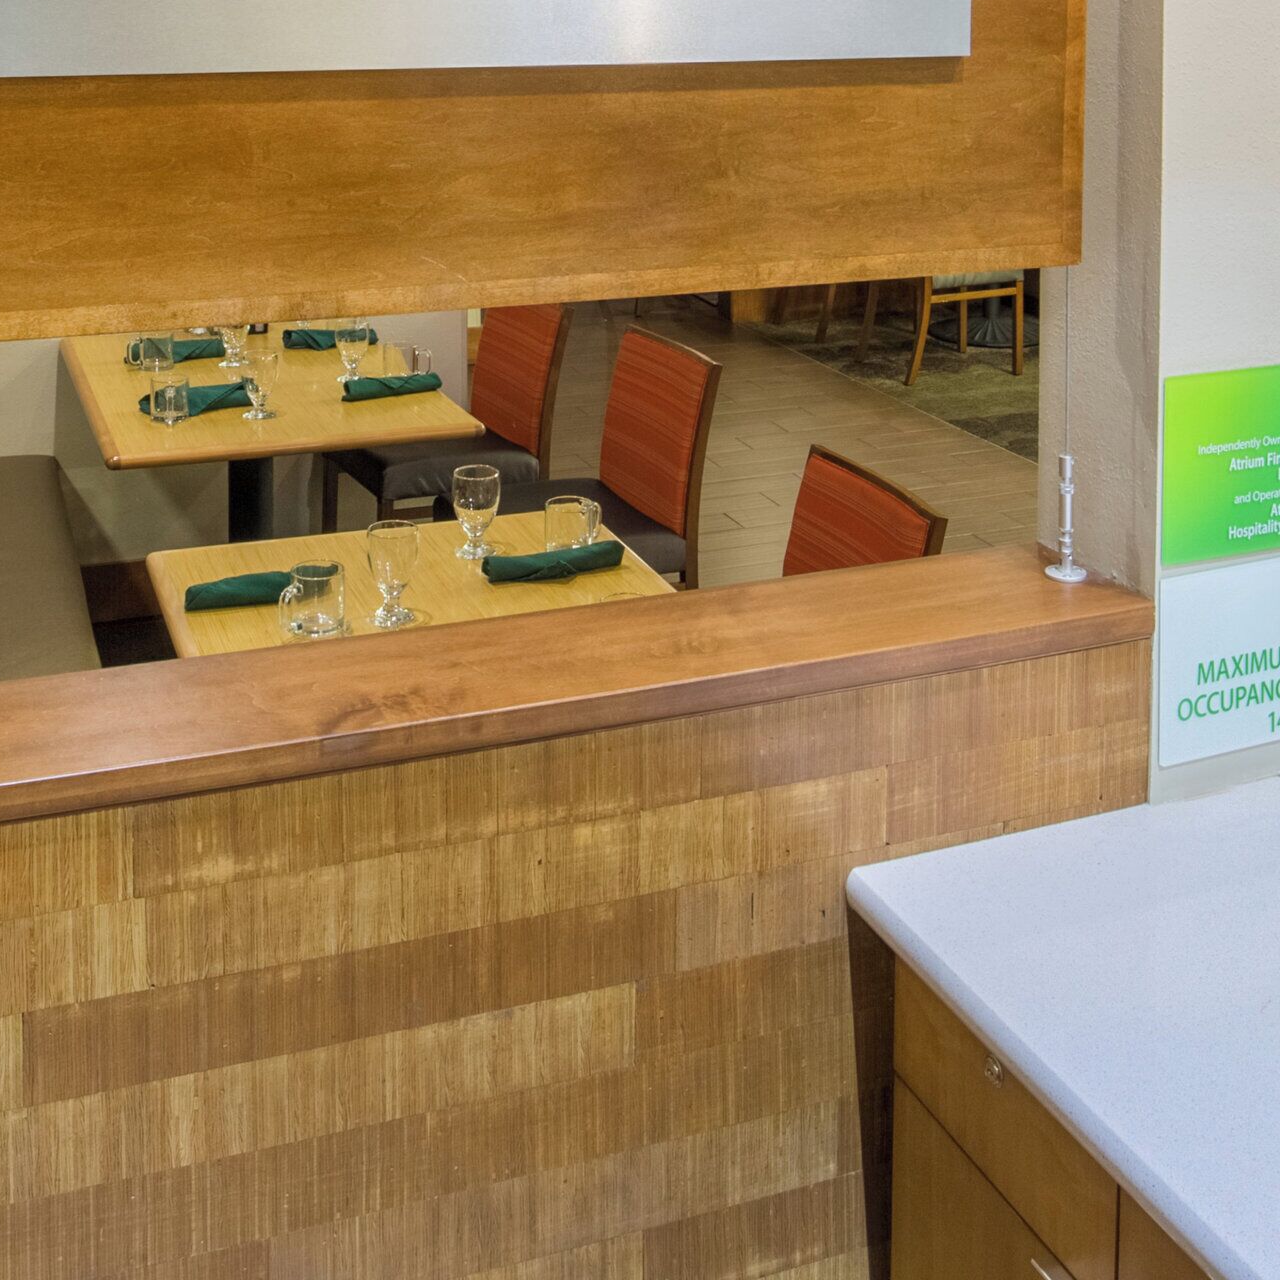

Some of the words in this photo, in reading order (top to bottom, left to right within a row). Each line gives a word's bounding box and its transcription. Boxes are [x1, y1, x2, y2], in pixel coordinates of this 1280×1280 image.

[1197, 436, 1261, 456] Independently
[1229, 455, 1265, 471] Atrium
[1233, 491, 1251, 504] and
